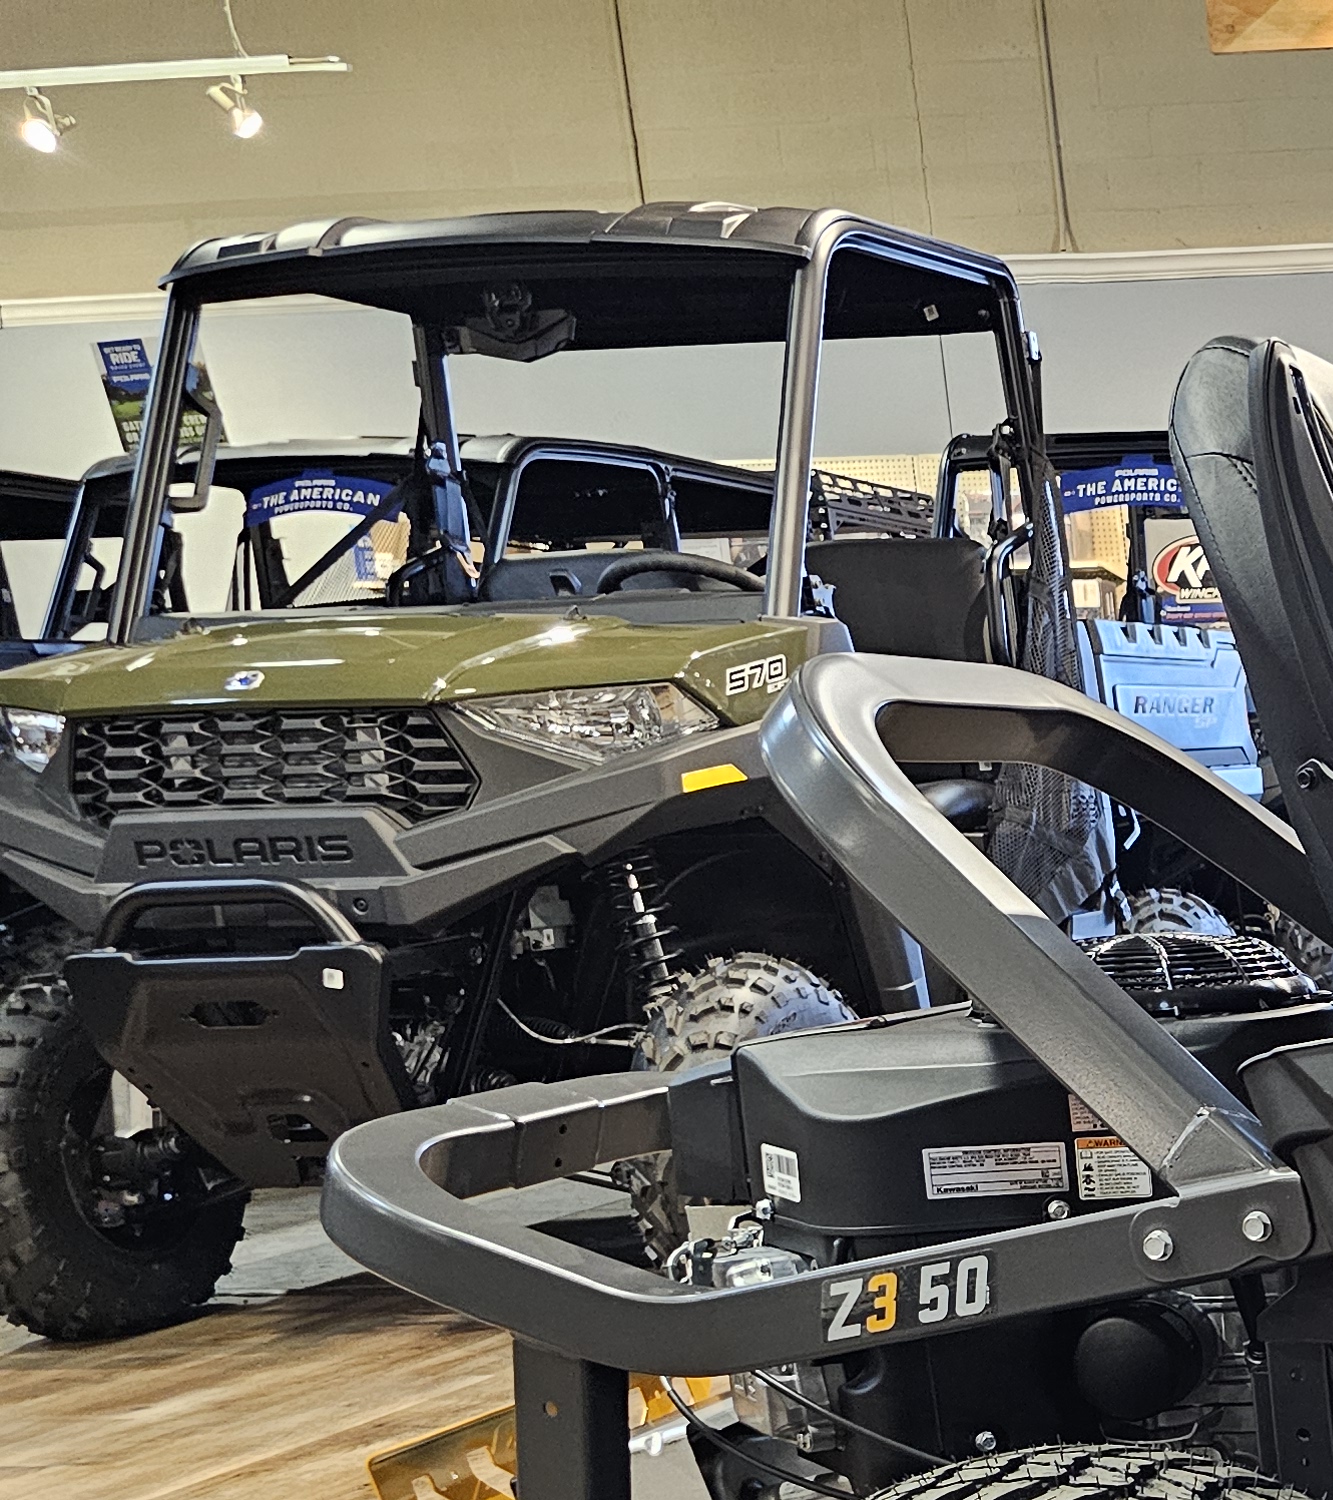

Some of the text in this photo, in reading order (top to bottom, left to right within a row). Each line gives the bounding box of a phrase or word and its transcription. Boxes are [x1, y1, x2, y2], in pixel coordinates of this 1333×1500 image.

[110, 351, 140, 366] RIDE
[1077, 478, 1182, 498] THE AMERIC
[262, 487, 381, 510] THE AMERICAN
[1094, 492, 1181, 505] POWERSPORTS CO.
[726, 654, 787, 697] 570
[1133, 695, 1215, 715] RANGER
[134, 834, 354, 869] POLARIS
[1094, 1139, 1127, 1147] WARN
[936, 1184, 979, 1194] Kawasaki
[827, 1255, 990, 1342] Z3 50
